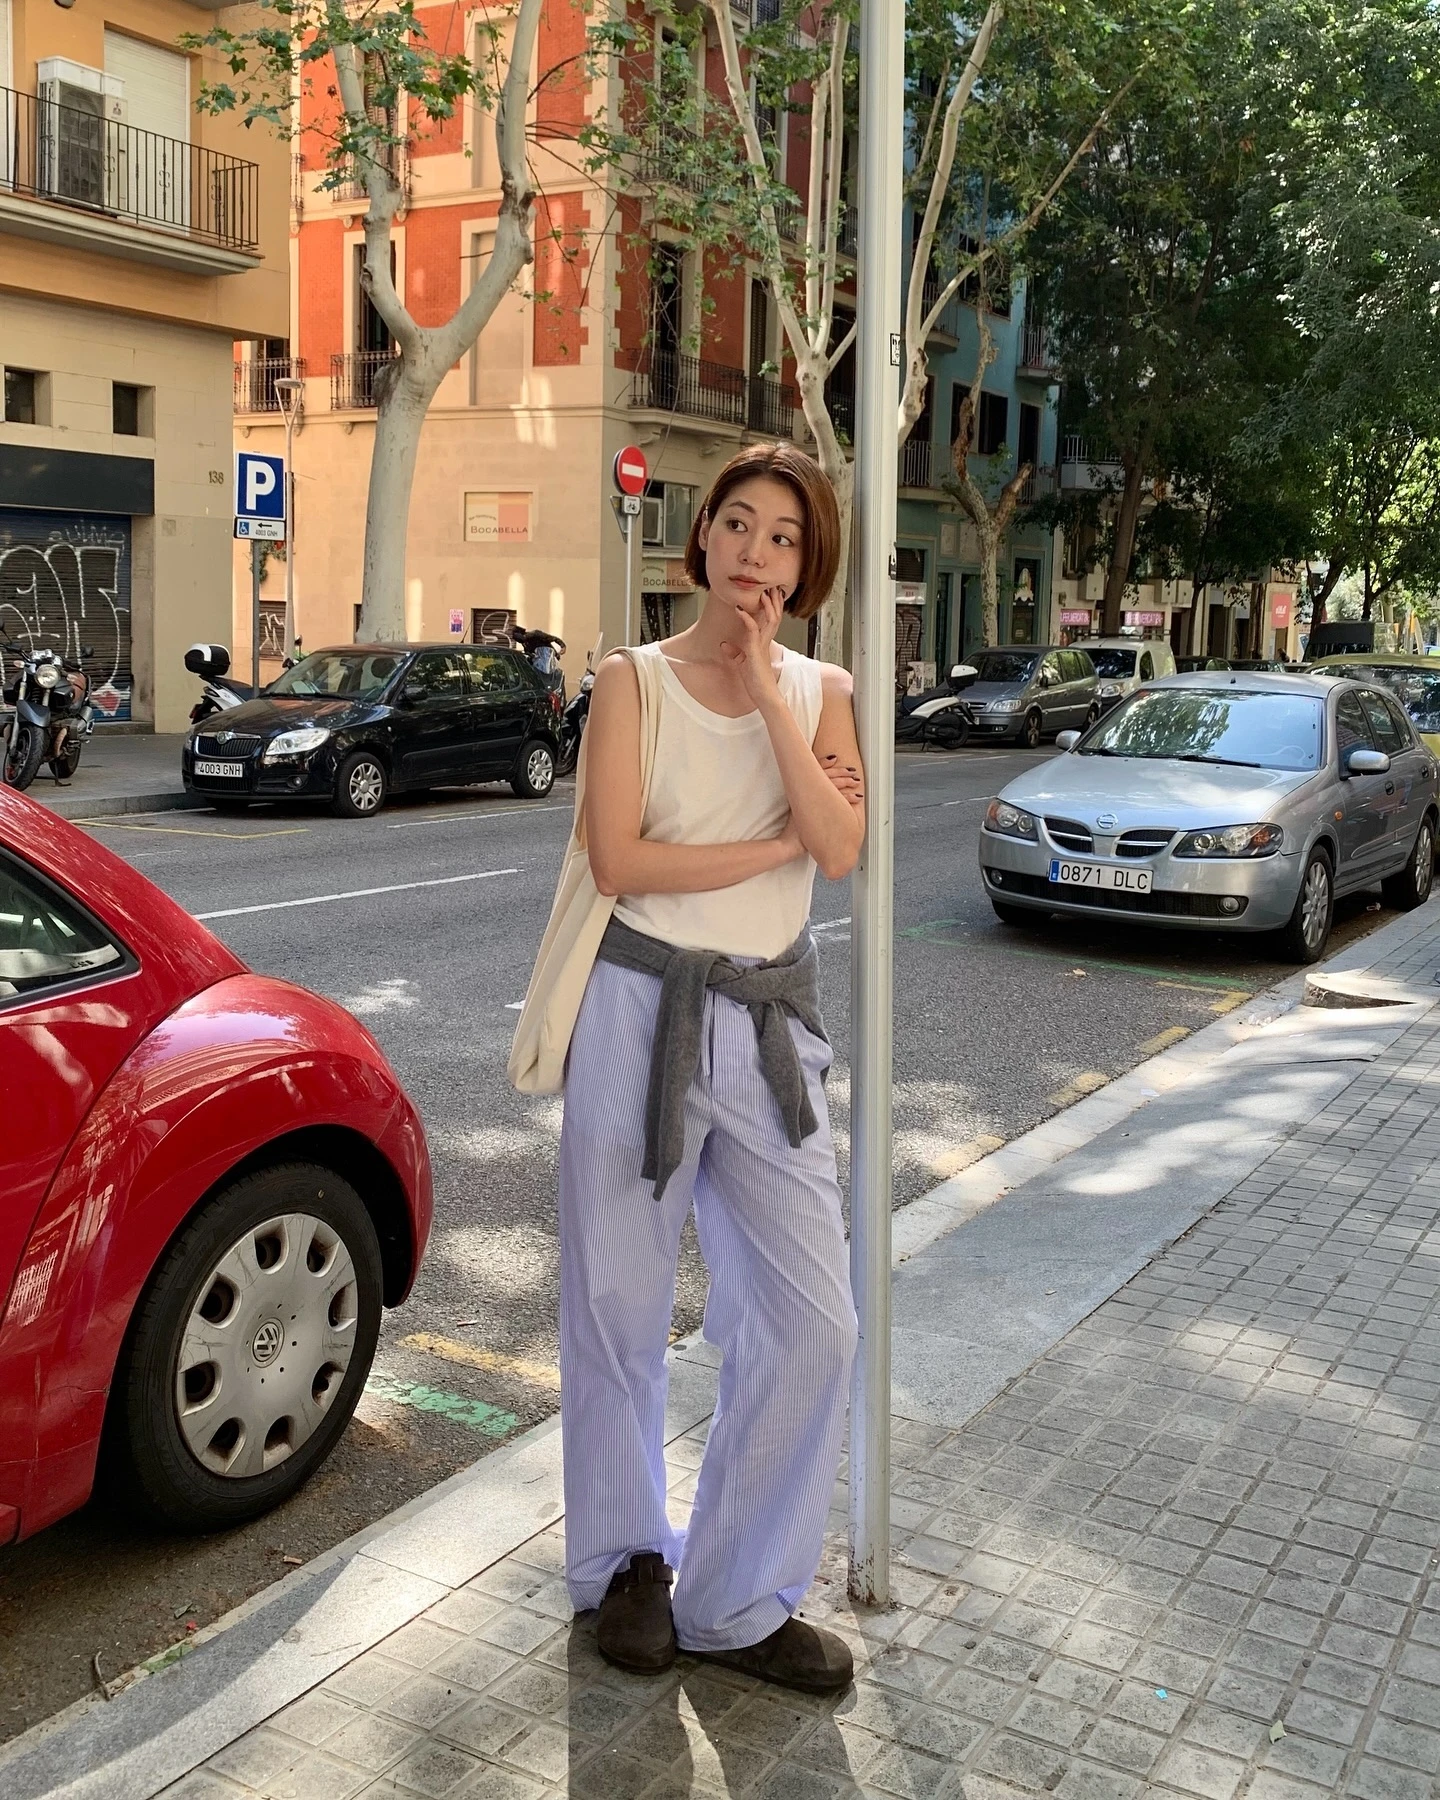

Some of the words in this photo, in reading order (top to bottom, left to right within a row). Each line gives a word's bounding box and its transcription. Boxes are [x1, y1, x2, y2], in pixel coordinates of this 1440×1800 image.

[208, 470, 224, 485] 138
[245, 459, 276, 511] P
[470, 525, 528, 534] BOCABELLA
[643, 577, 688, 587] BOCABELL
[198, 763, 221, 775] 4003
[223, 764, 241, 776] GNH
[1060, 864, 1101, 885] 0871
[1114, 870, 1148, 890] DLC
